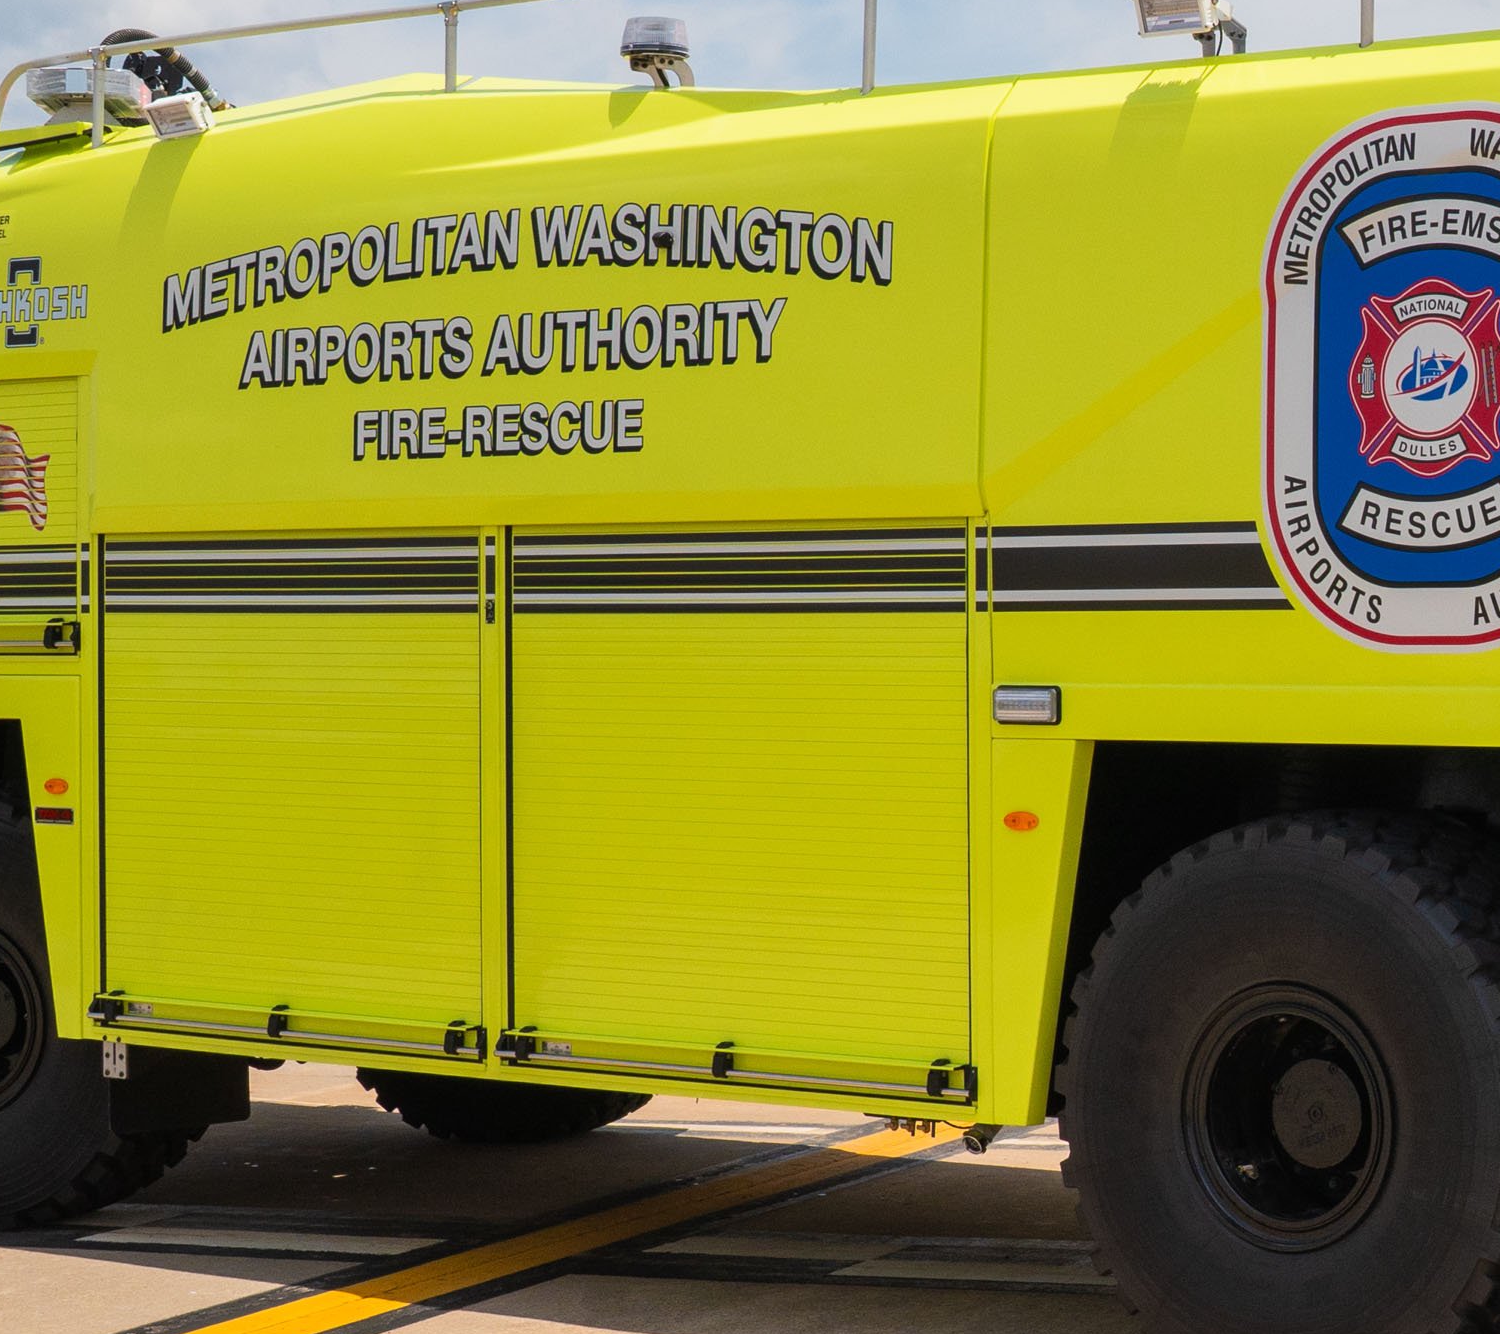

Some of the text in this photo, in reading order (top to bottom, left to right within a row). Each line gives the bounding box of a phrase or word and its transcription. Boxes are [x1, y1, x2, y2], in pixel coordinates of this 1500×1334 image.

[1284, 133, 1416, 285] METROPOLITAN
[162, 202, 893, 334] METROPOLITAN WASHINGTON
[1399, 298, 1461, 317] NATIONAL
[238, 297, 788, 390] AIRPORTS AUTHORITY
[353, 399, 644, 461] FIRE-RESCUE
[1398, 439, 1457, 457] DULLES
[1284, 475, 1382, 624] AIRPORTS
